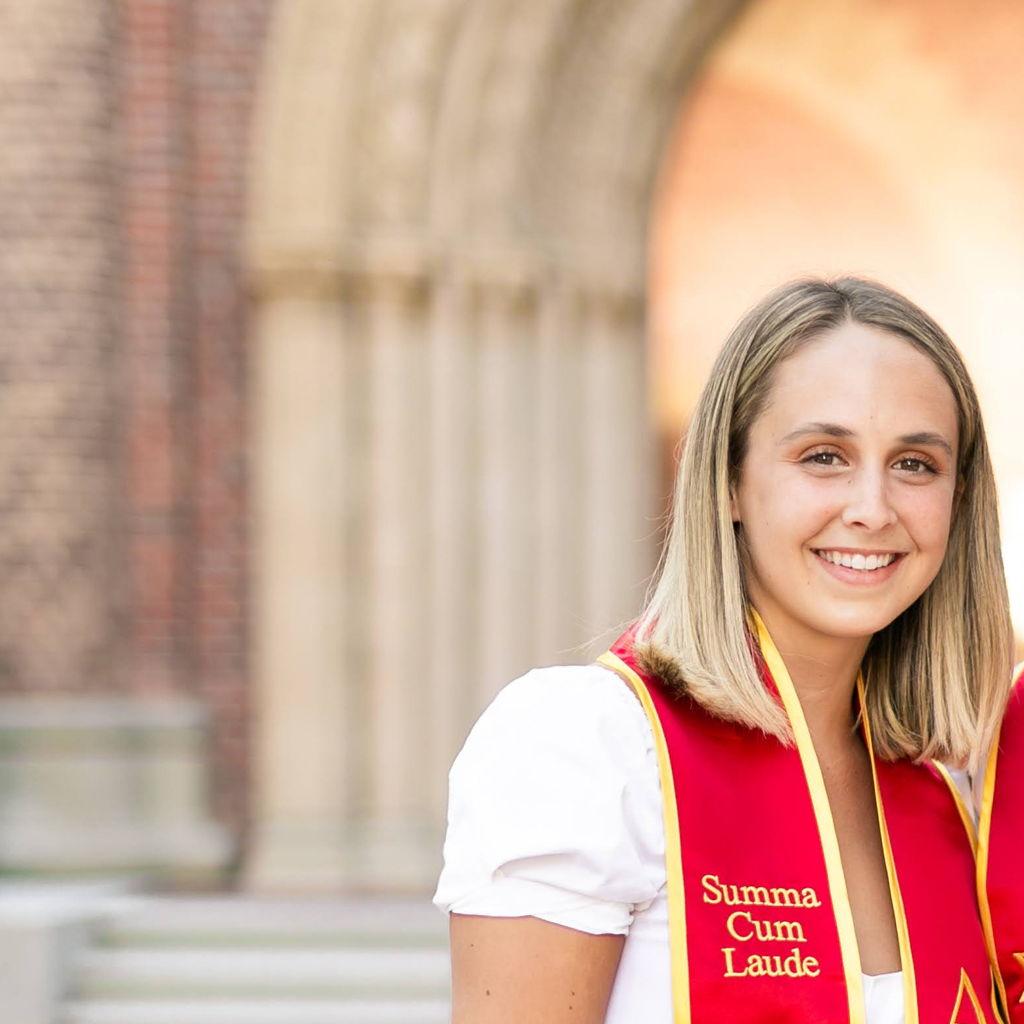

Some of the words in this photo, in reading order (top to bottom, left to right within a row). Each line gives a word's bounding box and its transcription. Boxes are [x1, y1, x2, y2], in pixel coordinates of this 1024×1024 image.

[701, 874, 821, 908] Summa
[726, 911, 807, 942] Cum
[721, 947, 820, 977] Laude
